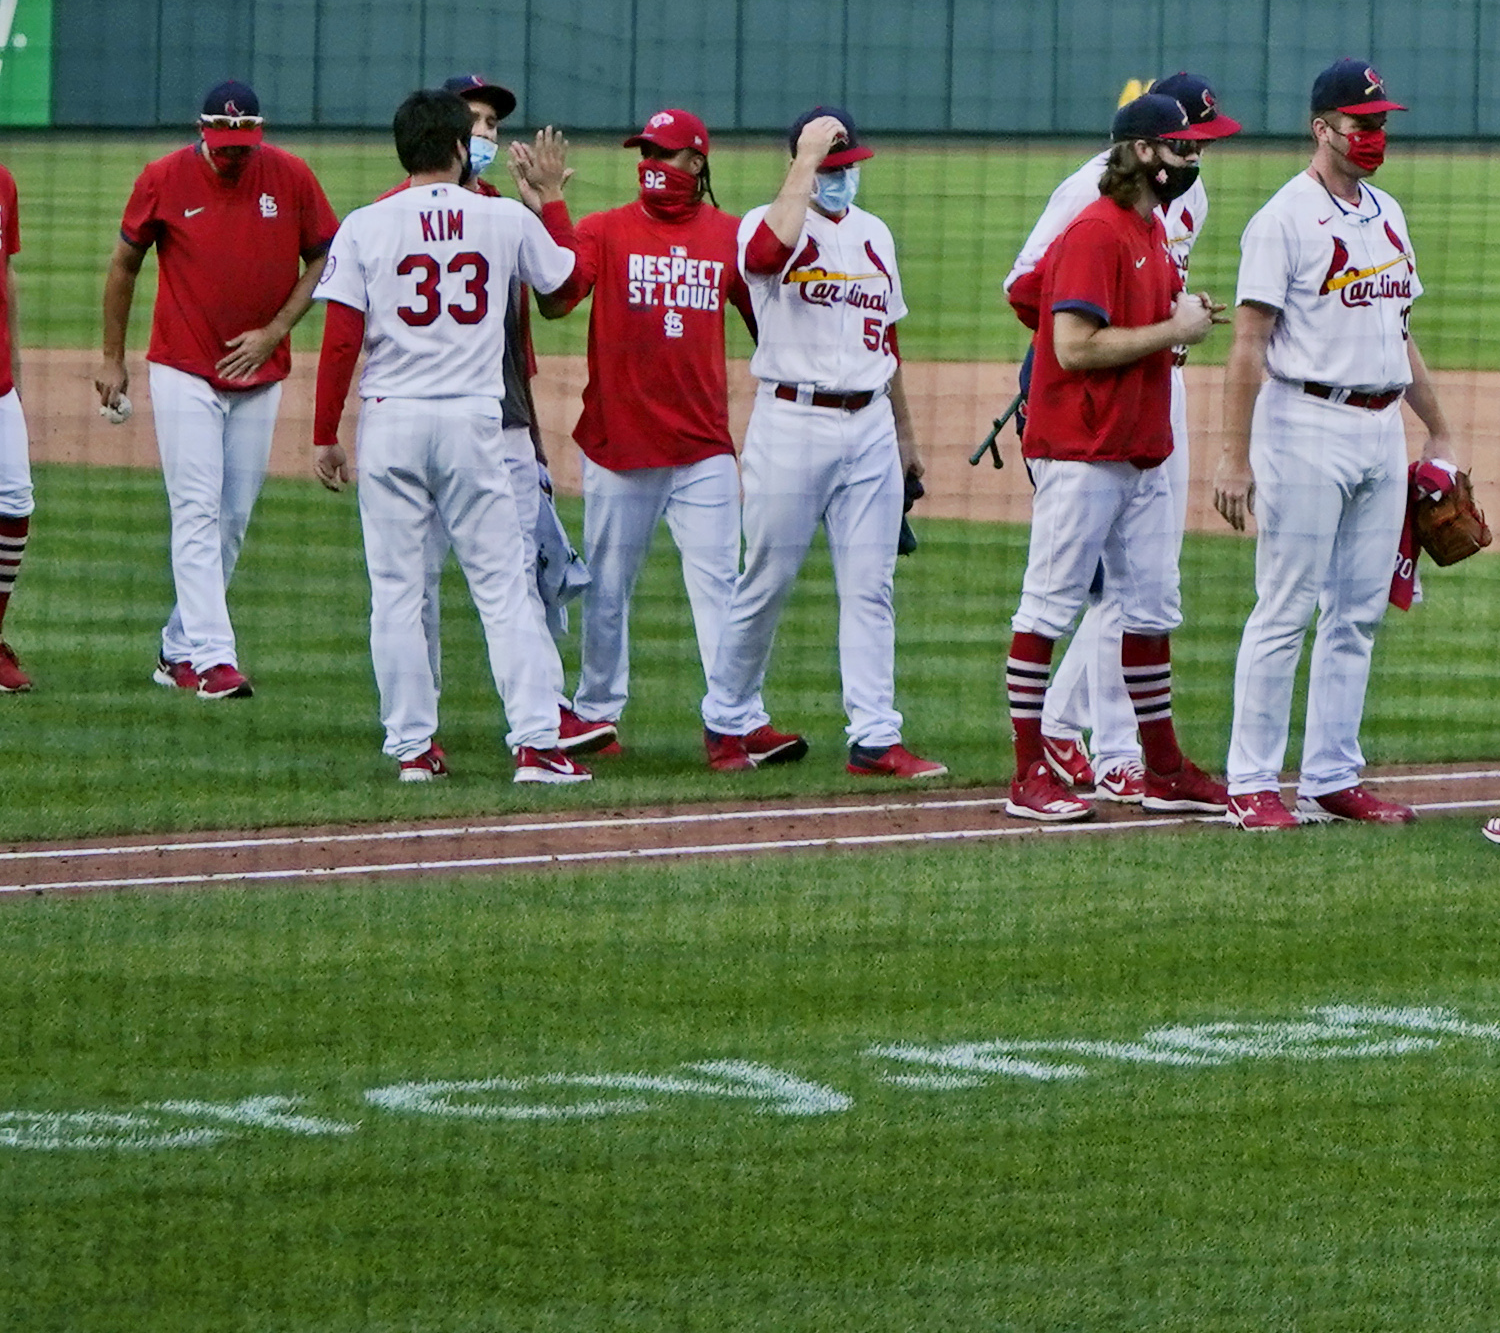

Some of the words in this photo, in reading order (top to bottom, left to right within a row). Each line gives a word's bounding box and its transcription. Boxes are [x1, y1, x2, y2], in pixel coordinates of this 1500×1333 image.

[643, 171, 667, 190] 92
[419, 209, 464, 242] KIM
[628, 253, 725, 285] RESPECT
[397, 251, 490, 327] 33
[628, 281, 660, 306] ST.
[663, 282, 719, 309] LOUIS
